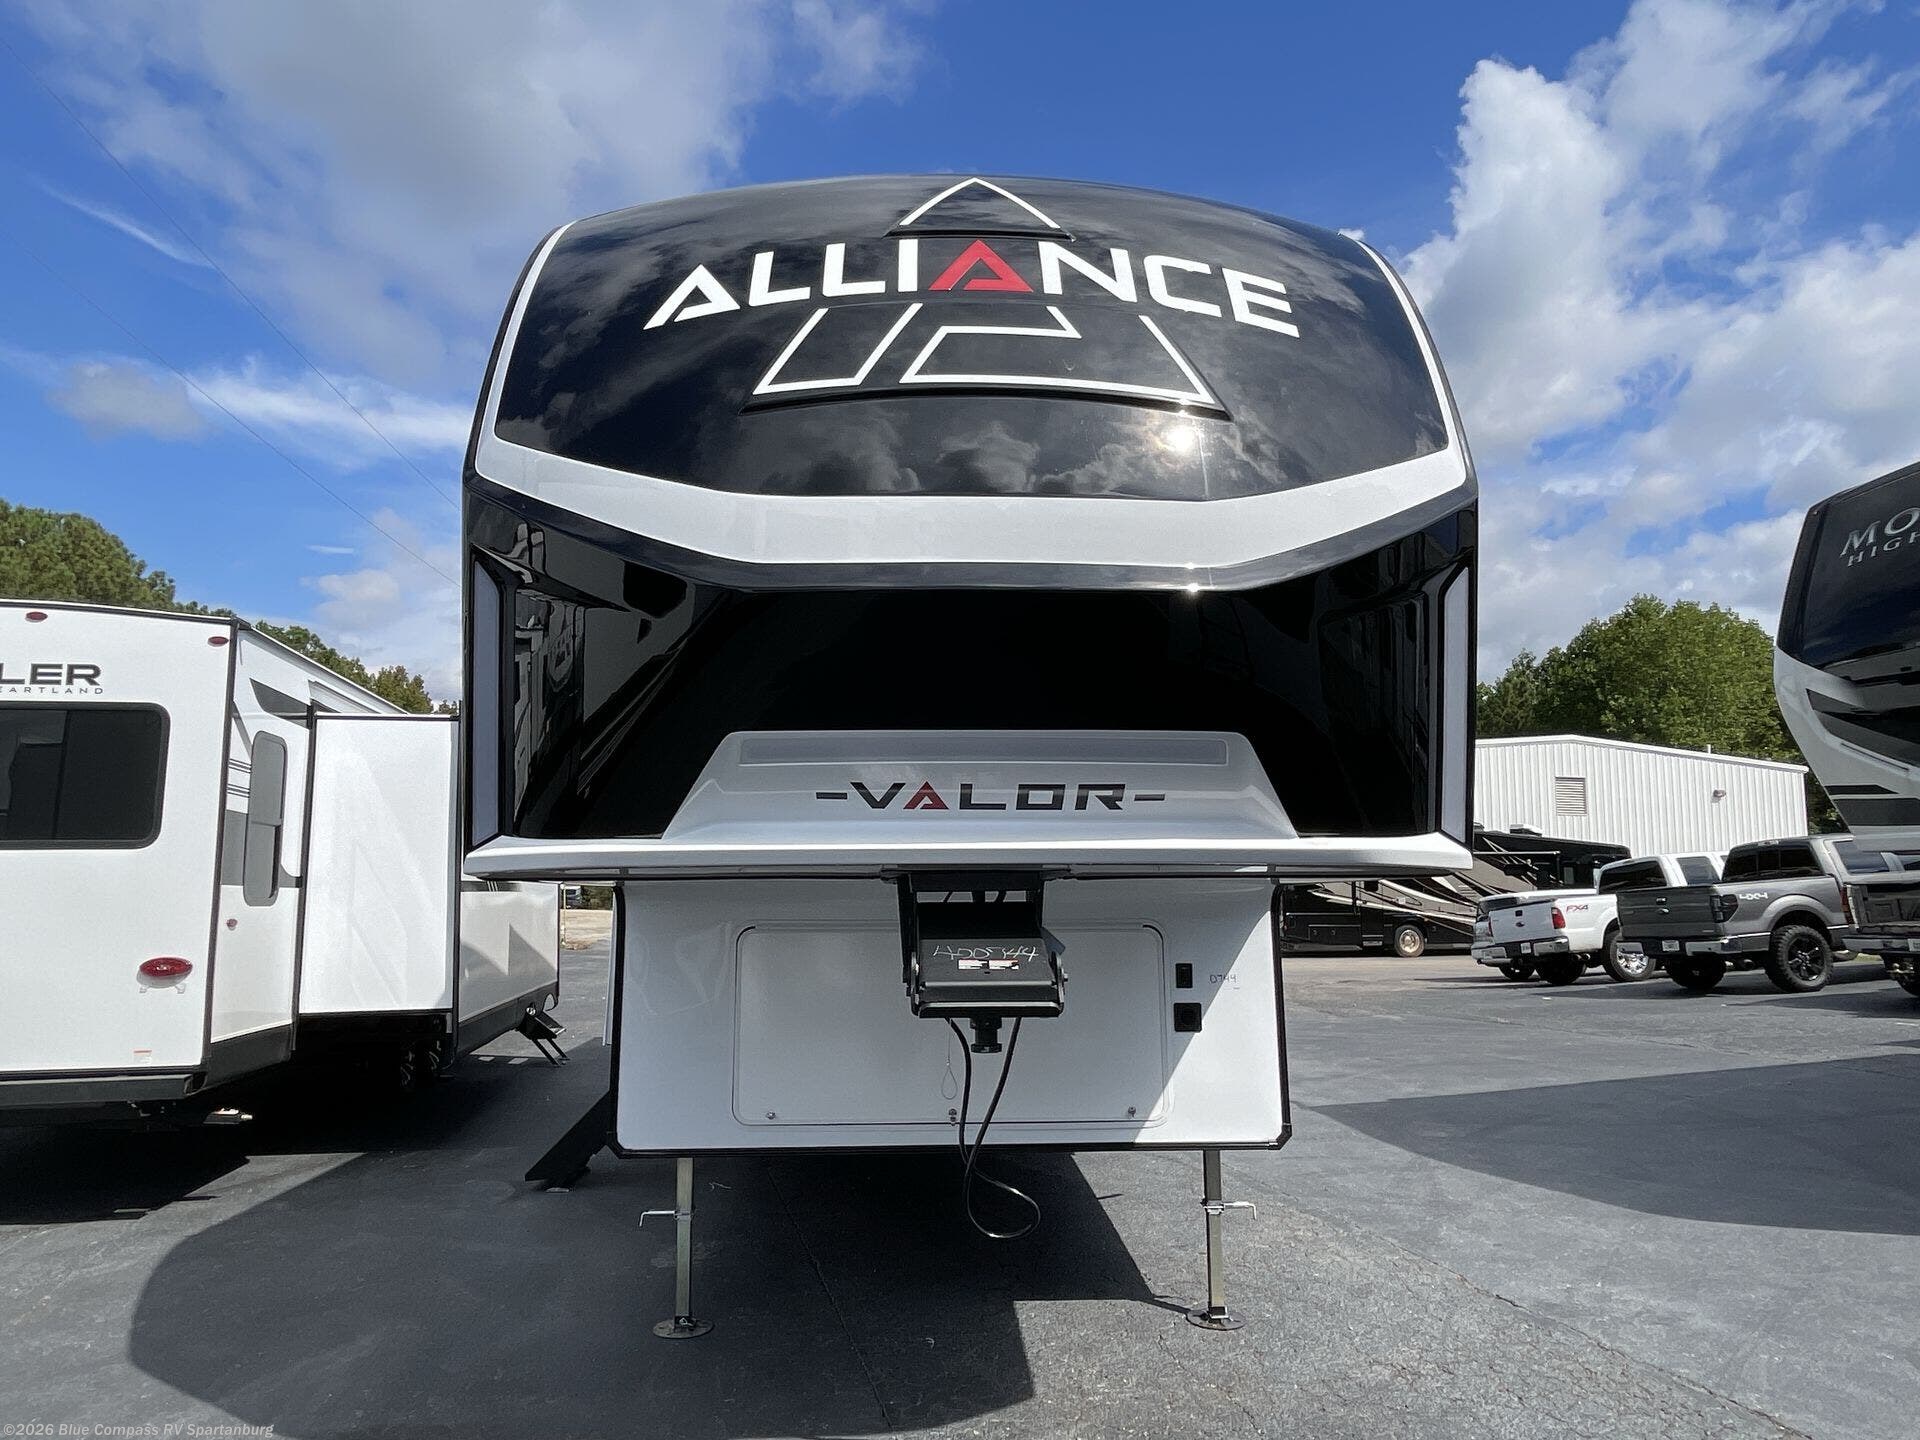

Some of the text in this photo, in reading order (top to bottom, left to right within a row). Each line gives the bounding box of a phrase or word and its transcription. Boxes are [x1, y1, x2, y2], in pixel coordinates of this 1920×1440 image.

[643, 239, 1300, 338] ALLIANCE
[0, 663, 101, 686] LER
[1566, 904, 1589, 912] FX4
